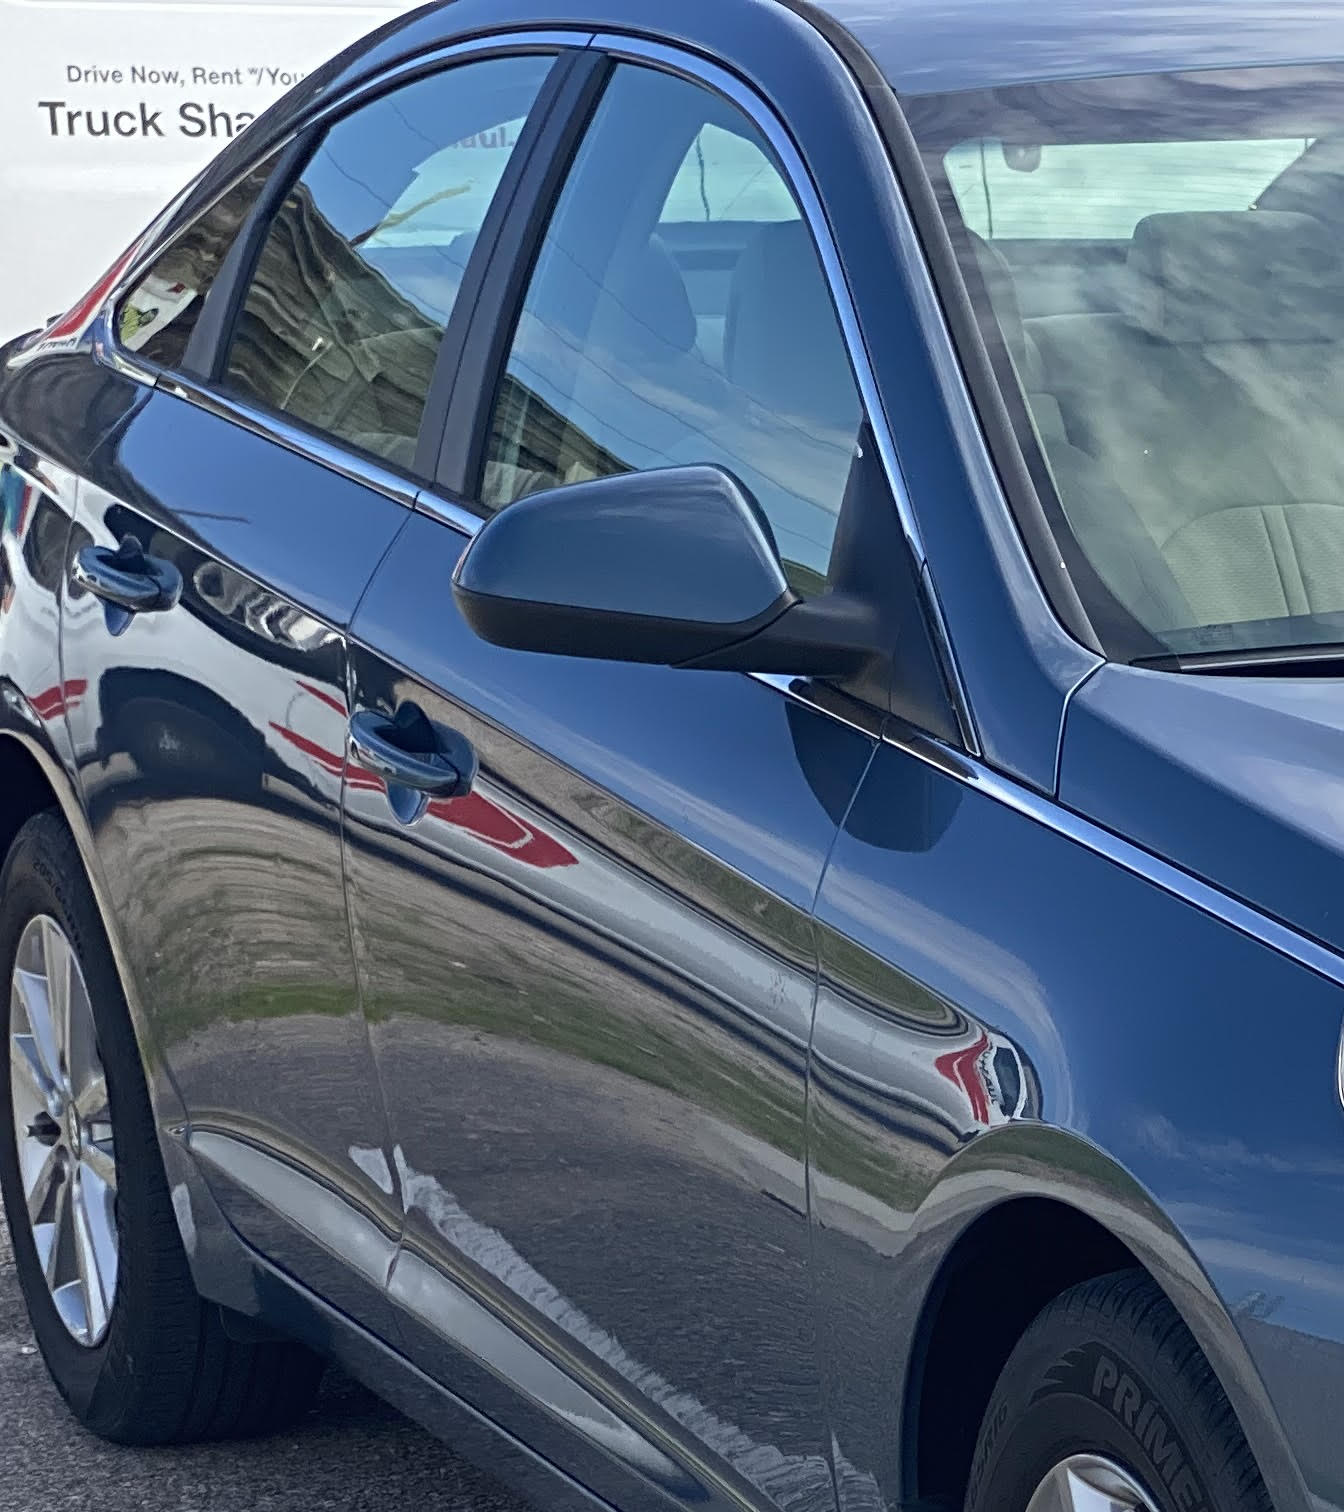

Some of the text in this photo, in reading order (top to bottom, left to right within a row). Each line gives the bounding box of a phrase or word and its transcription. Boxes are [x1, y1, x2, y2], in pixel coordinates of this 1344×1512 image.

[66, 65, 123, 84] Drive
[131, 66, 186, 88] Now,
[192, 67, 243, 86] Rent
[38, 101, 167, 138] Truck
